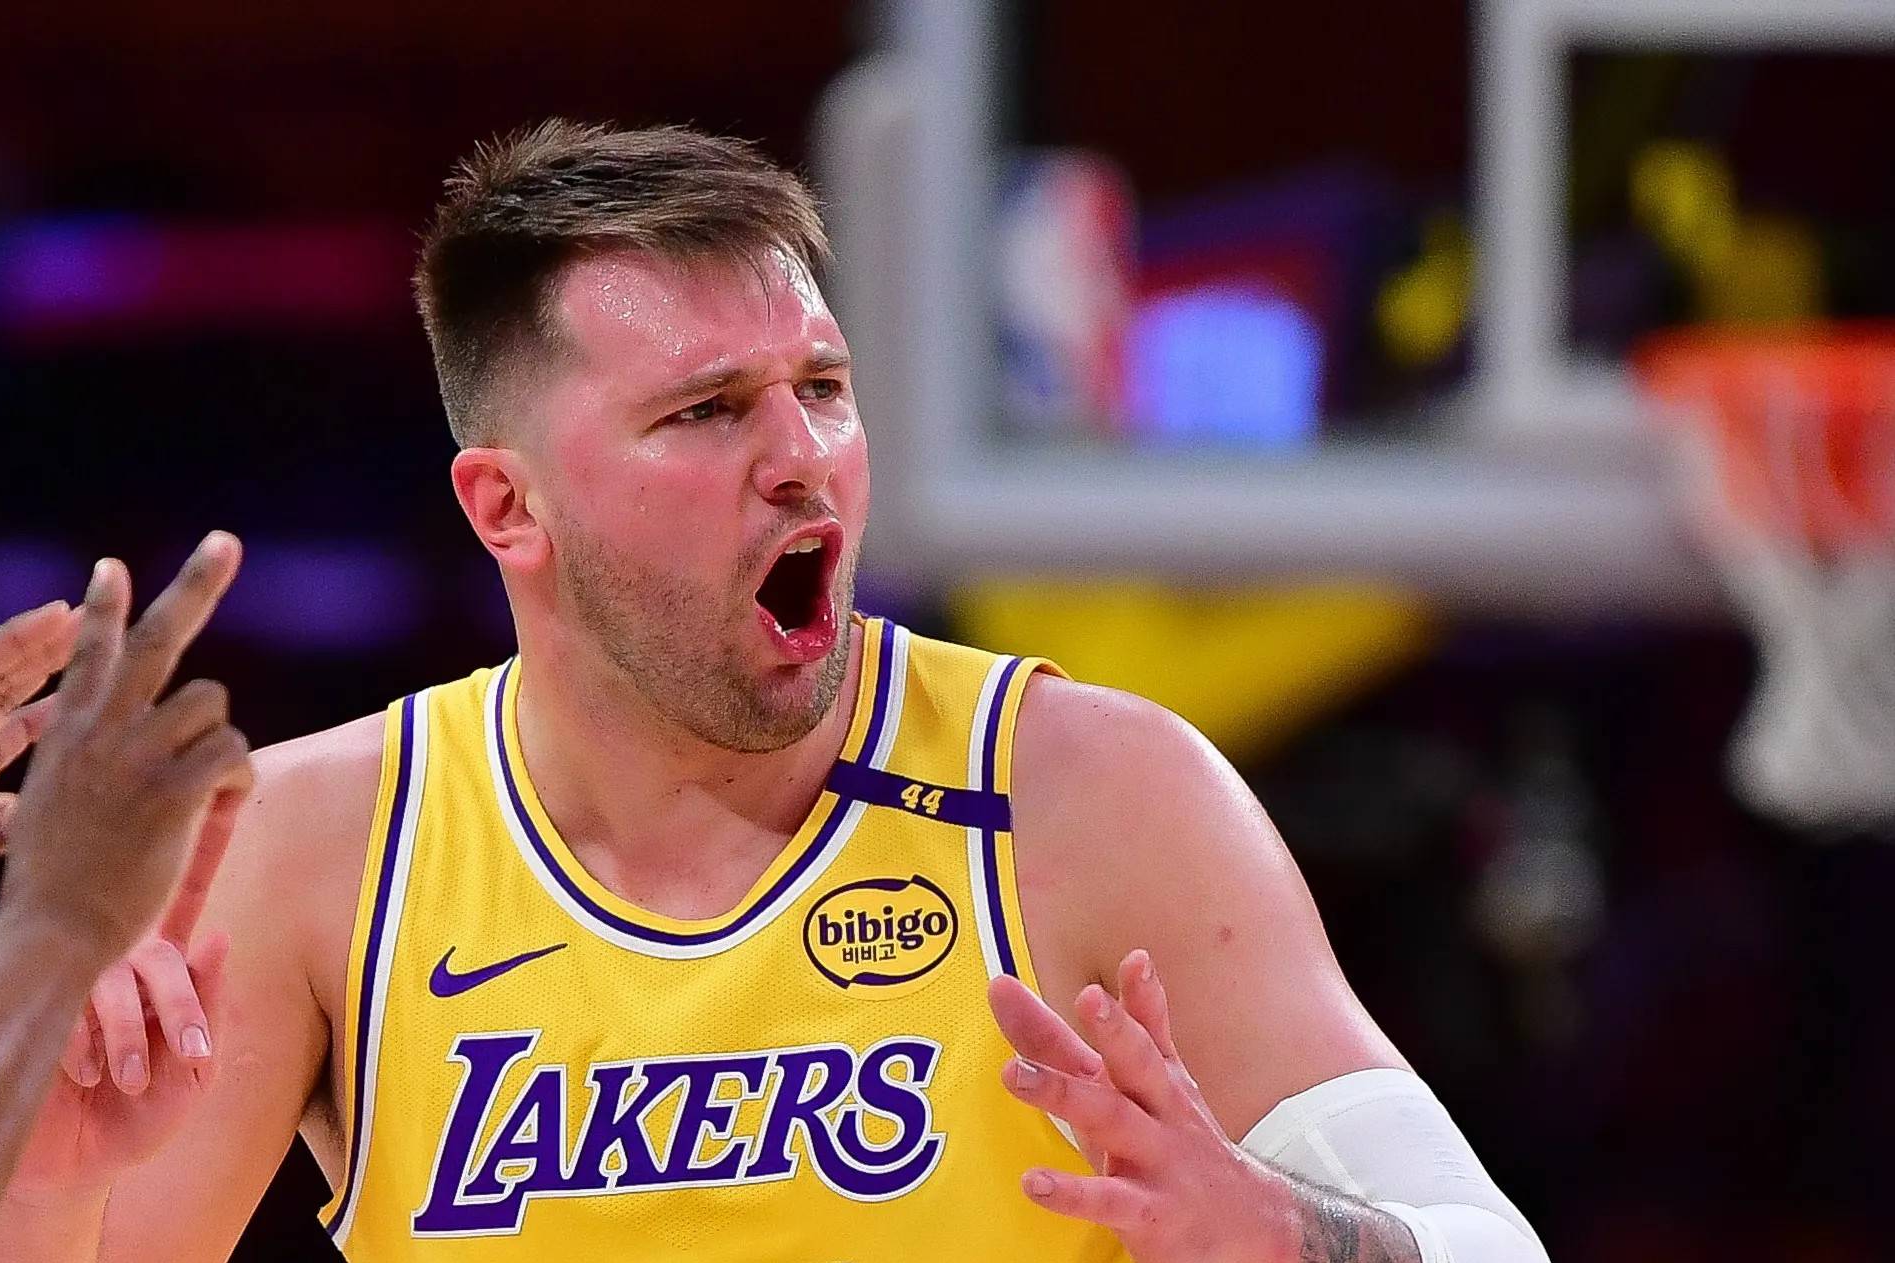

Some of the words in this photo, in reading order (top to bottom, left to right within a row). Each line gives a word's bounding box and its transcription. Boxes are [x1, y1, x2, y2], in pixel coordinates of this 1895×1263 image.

[900, 783, 944, 815] 44
[817, 905, 948, 949] bibigo
[841, 944, 897, 963] 비비고
[411, 1029, 946, 1237] LAKERS
